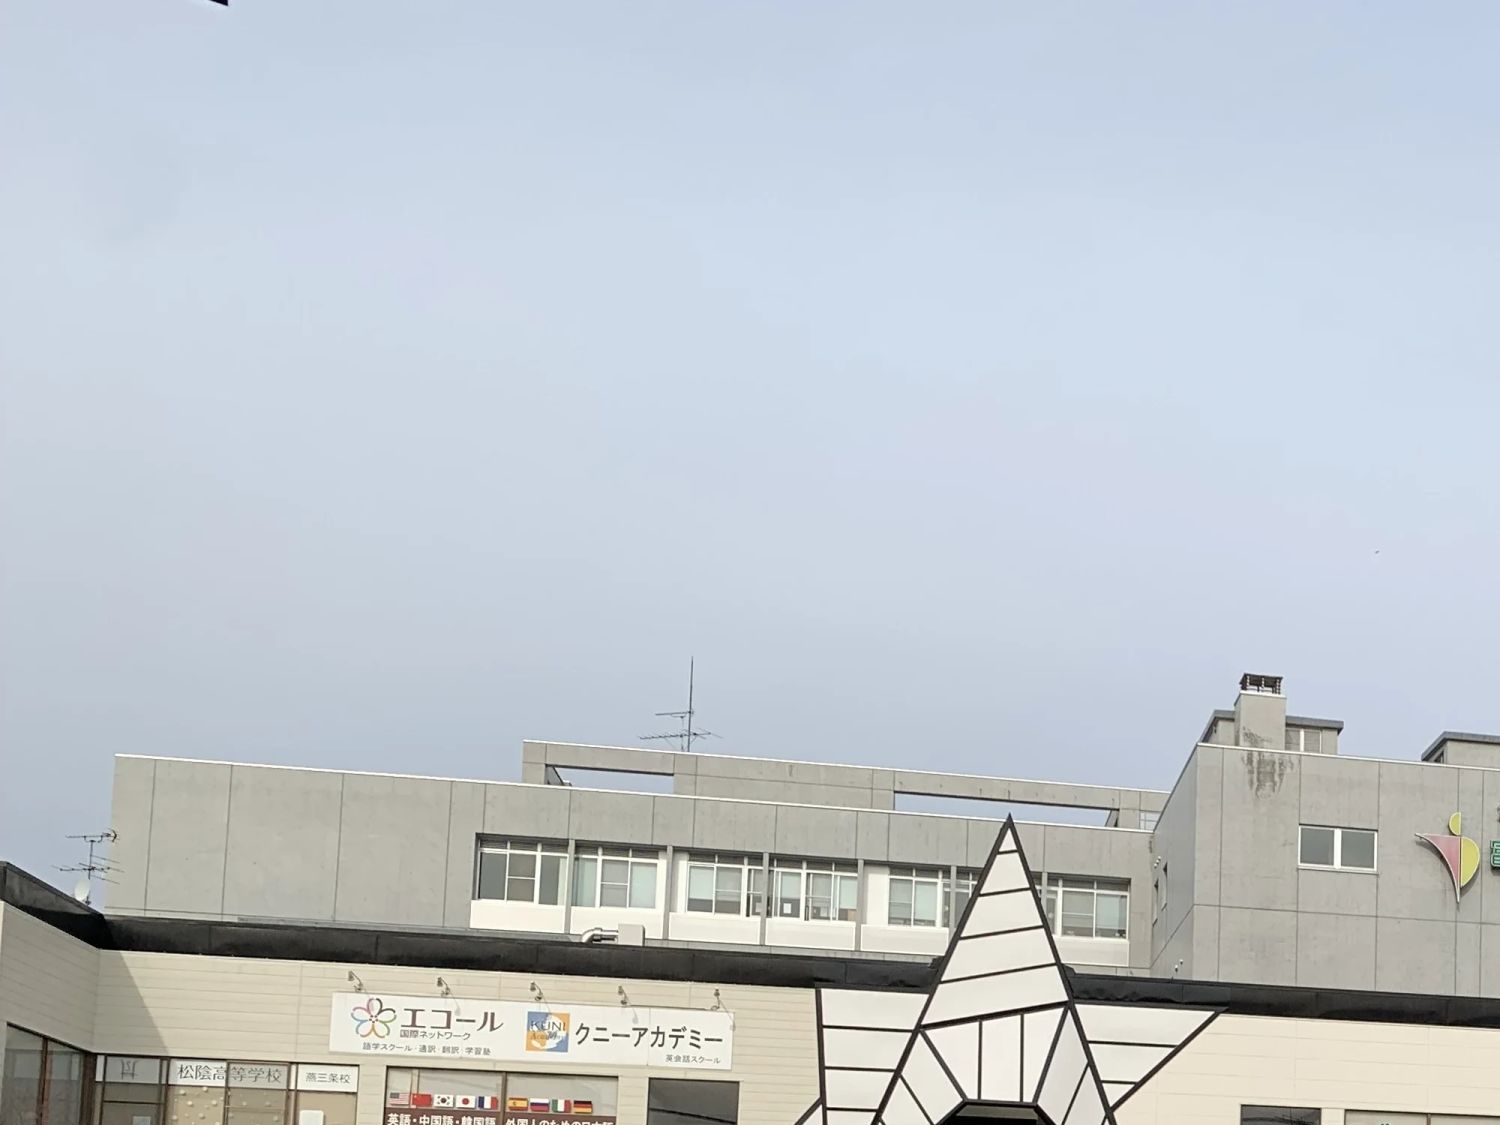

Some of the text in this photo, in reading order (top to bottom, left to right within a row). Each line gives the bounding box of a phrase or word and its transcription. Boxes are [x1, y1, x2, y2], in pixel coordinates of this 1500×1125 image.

[401, 1008, 504, 1032] エコール
[530, 1021, 566, 1031] KUNI
[400, 1029, 471, 1041] 国際ネットワーク
[575, 1022, 723, 1050] クニーアカデミー
[665, 1054, 721, 1065] 英会話スクール
[177, 1063, 283, 1084] 松陰高等学校
[305, 1072, 352, 1084] 燕三条校
